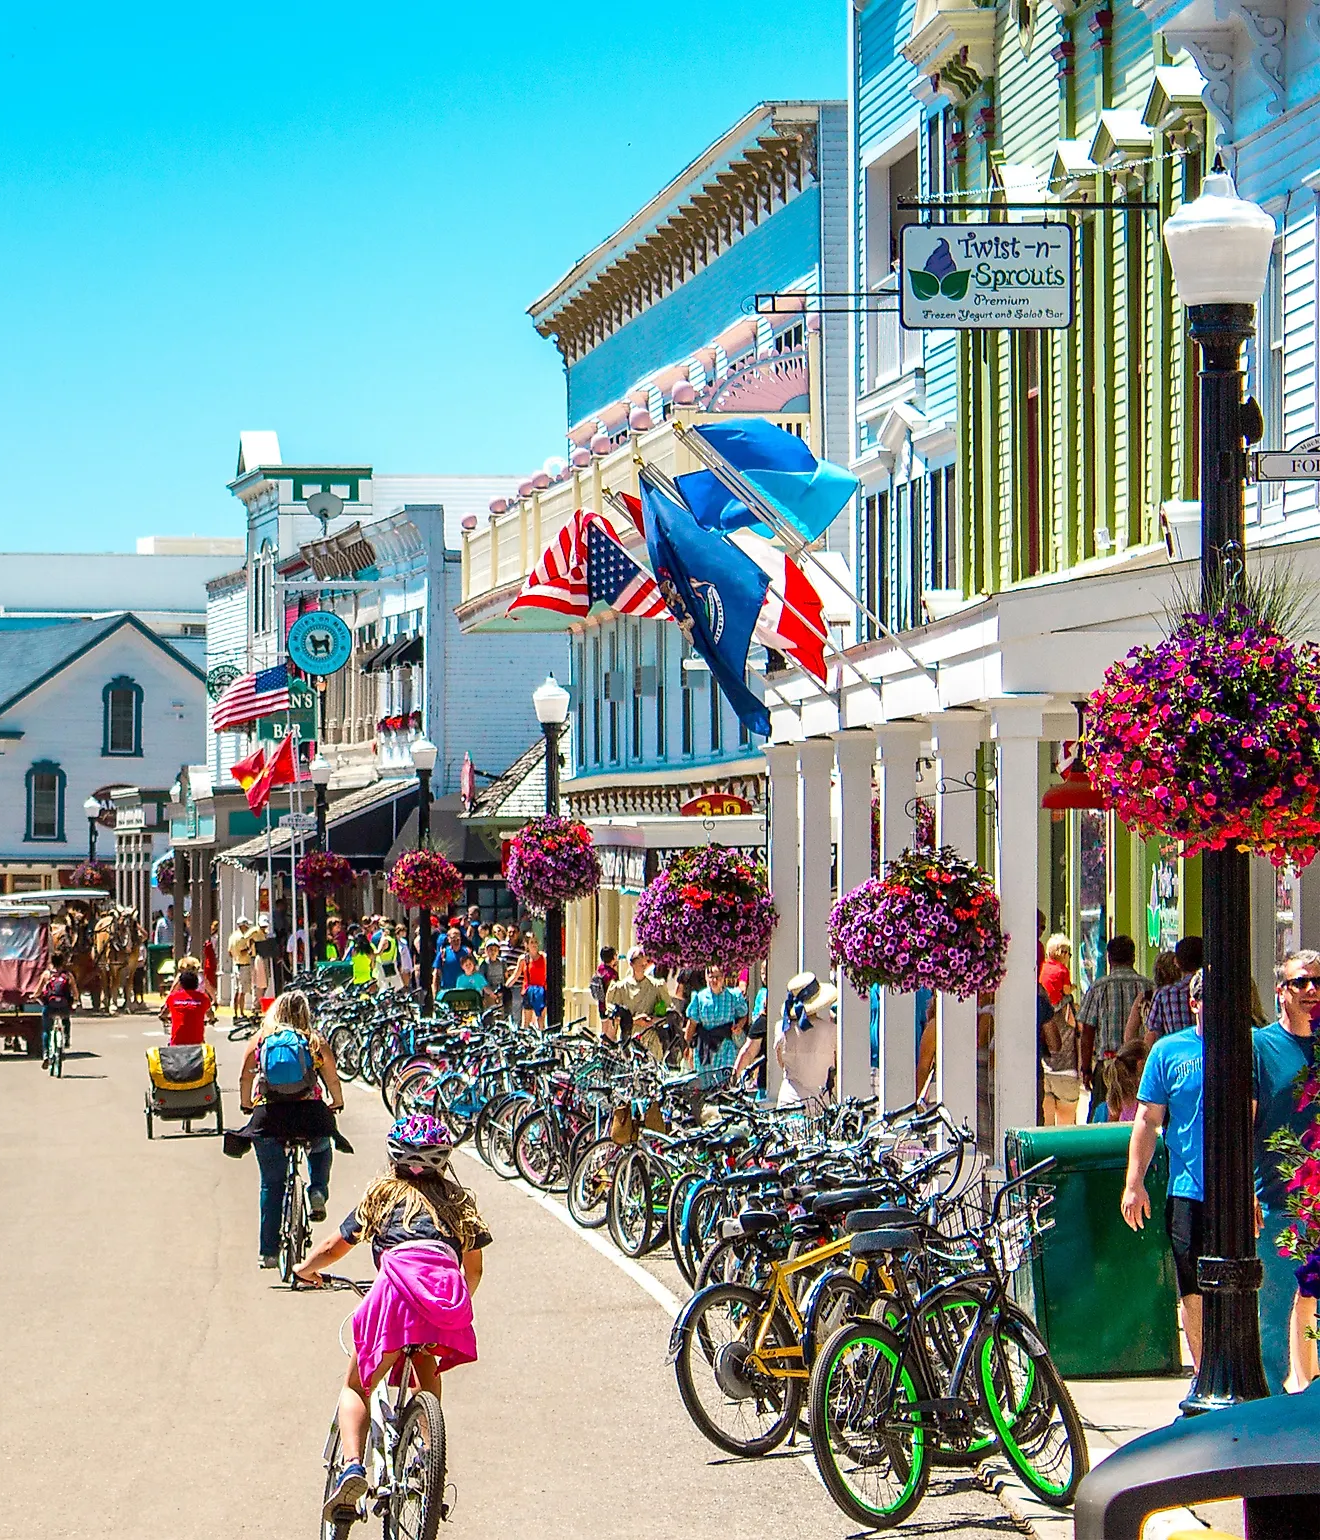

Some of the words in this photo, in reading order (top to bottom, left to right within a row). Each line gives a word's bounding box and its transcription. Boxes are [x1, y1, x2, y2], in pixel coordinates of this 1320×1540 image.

[958, 232, 1021, 259] Twist
[973, 294, 1030, 306] Premium
[922, 309, 956, 319] Frozen
[994, 309, 1012, 319] and
[1014, 309, 1043, 319] Salad
[1045, 309, 1064, 319] Bar
[1291, 459, 1320, 473] FO
[289, 693, 313, 709] N'S
[273, 723, 303, 739] BAR
